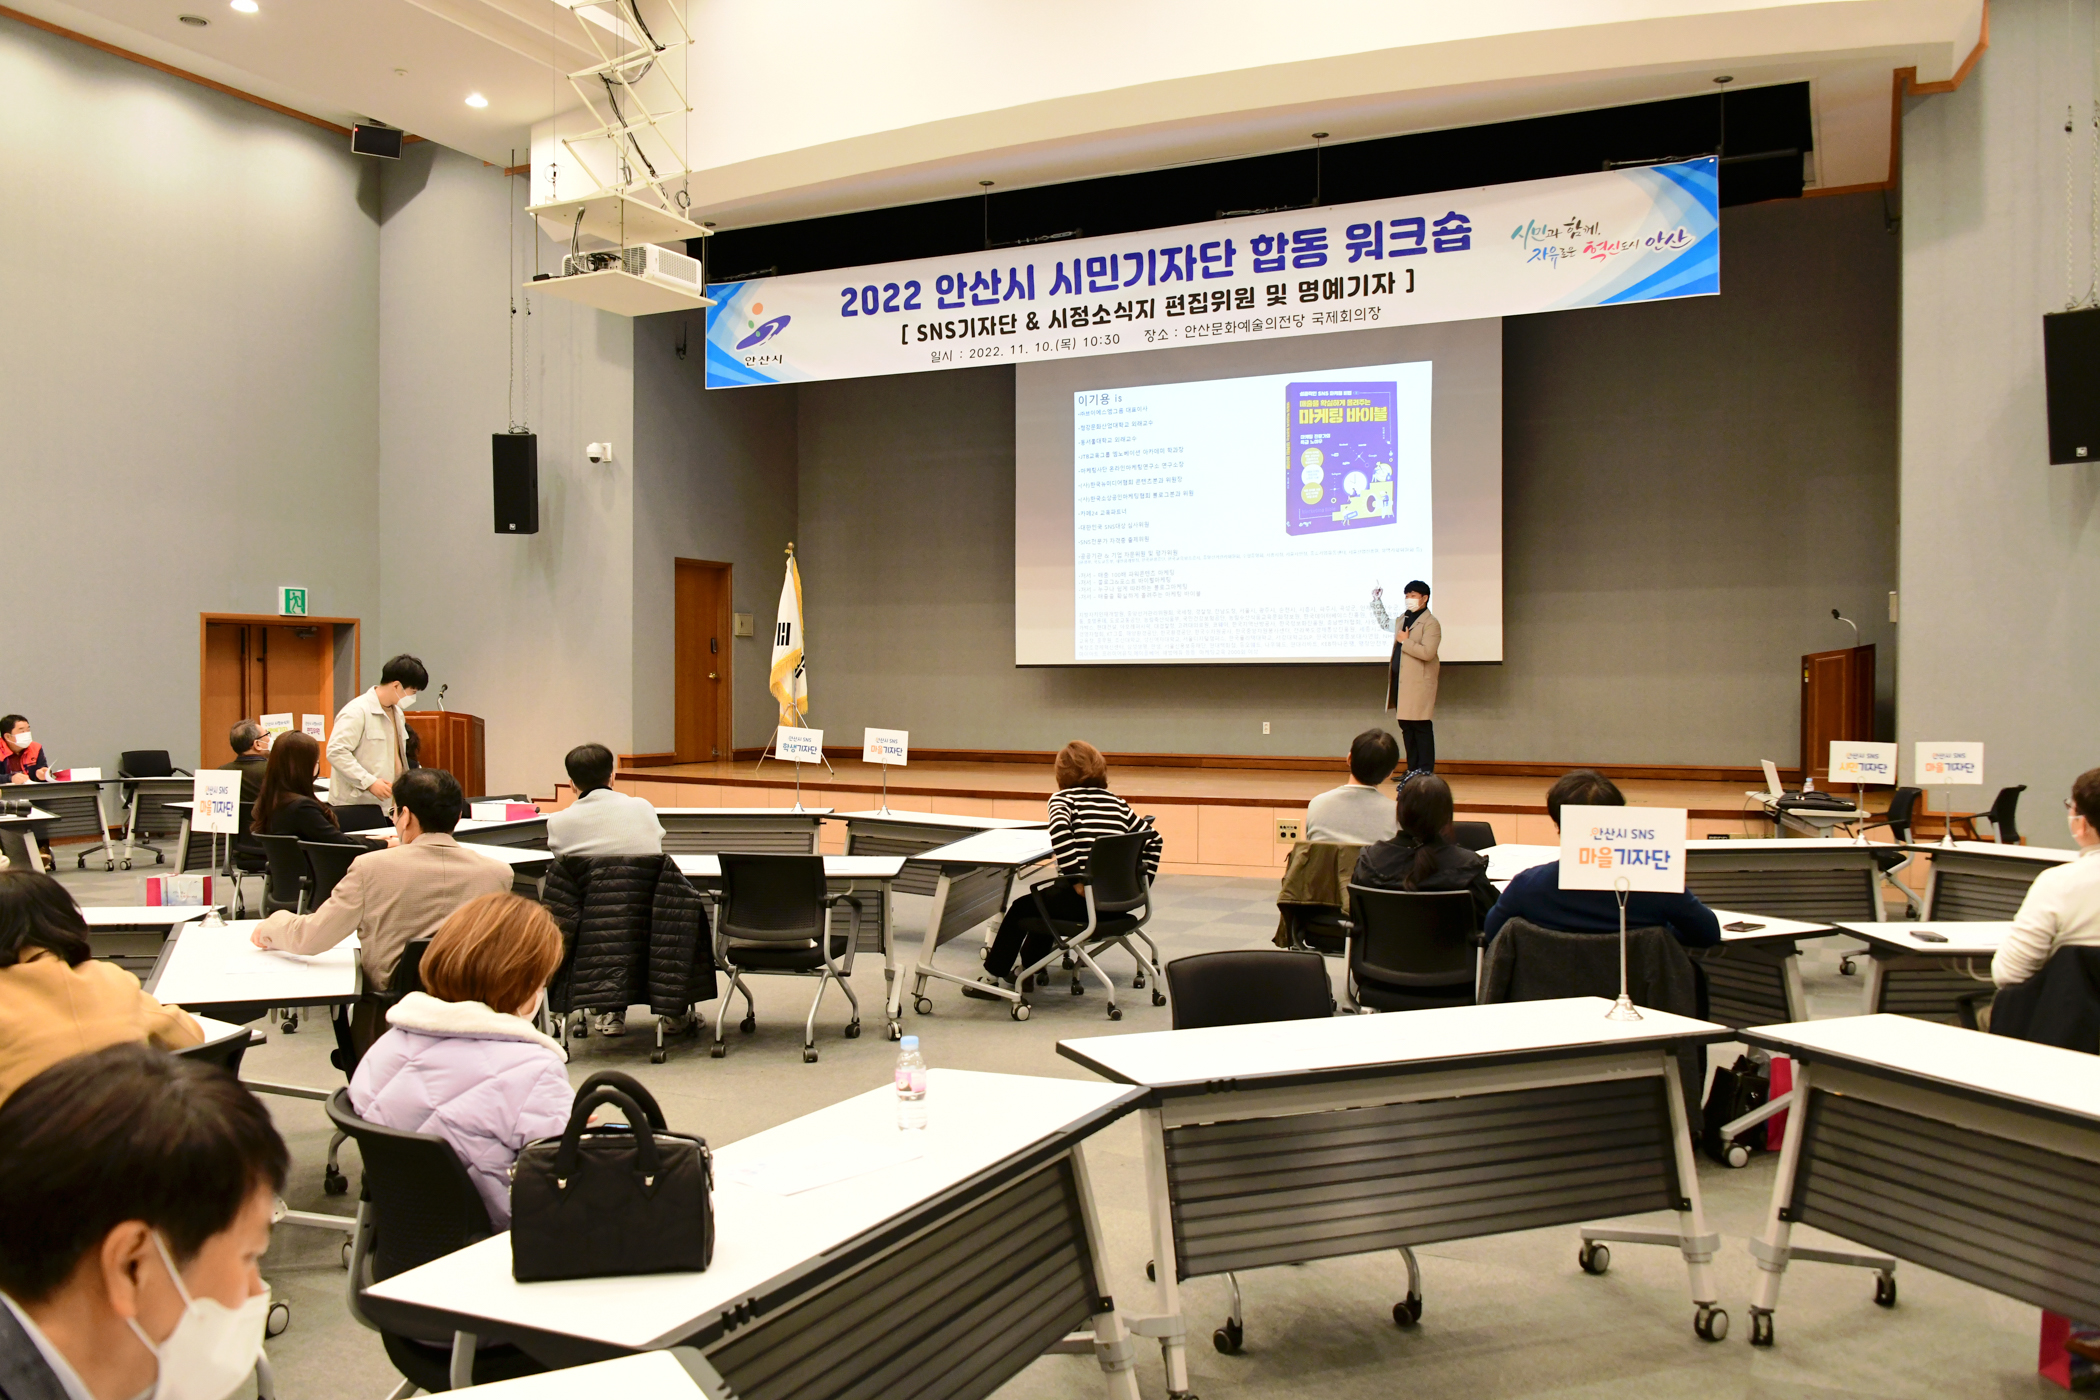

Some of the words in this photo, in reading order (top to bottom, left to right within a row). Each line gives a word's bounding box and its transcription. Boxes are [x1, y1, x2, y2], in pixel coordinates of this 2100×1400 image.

[1645, 229, 1693, 251] 안산
[840, 280, 922, 318] 2022
[935, 264, 1036, 310] 안산시
[1048, 238, 1237, 296] 시민기자단
[1250, 227, 1329, 274] 합동
[1345, 210, 1473, 263] 워크숍
[916, 313, 1018, 342] SNS기자단
[1026, 311, 1040, 331] &
[1048, 298, 1155, 329] 시정소식지
[1165, 286, 1255, 317] 편집위원
[1266, 283, 1287, 307] 및
[1298, 271, 1396, 303] 명예기자
[931, 350, 953, 363] 일시
[969, 347, 1004, 359] 2022.
[1010, 344, 1028, 354] 11.
[1083, 333, 1121, 347] 10:30
[1144, 328, 1169, 343] 장소
[1184, 313, 1305, 339] 안산문화예술의전당
[1311, 306, 1382, 325] 국제회의장
[745, 354, 783, 366] 안산시
[1078, 393, 1110, 406] 이기용
[1114, 394, 1123, 403] is
[1299, 408, 1344, 424] 마케팅
[1346, 406, 1388, 422] 바이블
[782, 742, 818, 755] 학생기자단
[870, 744, 903, 756] 마을기자단
[1839, 762, 1888, 774] 시민기자단
[1925, 762, 1975, 773] 마을기자단
[218, 786, 229, 795] SNS
[199, 799, 234, 817] 마을기자단
[1590, 827, 1627, 841] 안산시
[1631, 829, 1655, 840] SNS
[1578, 847, 1671, 871] 마을기자단
